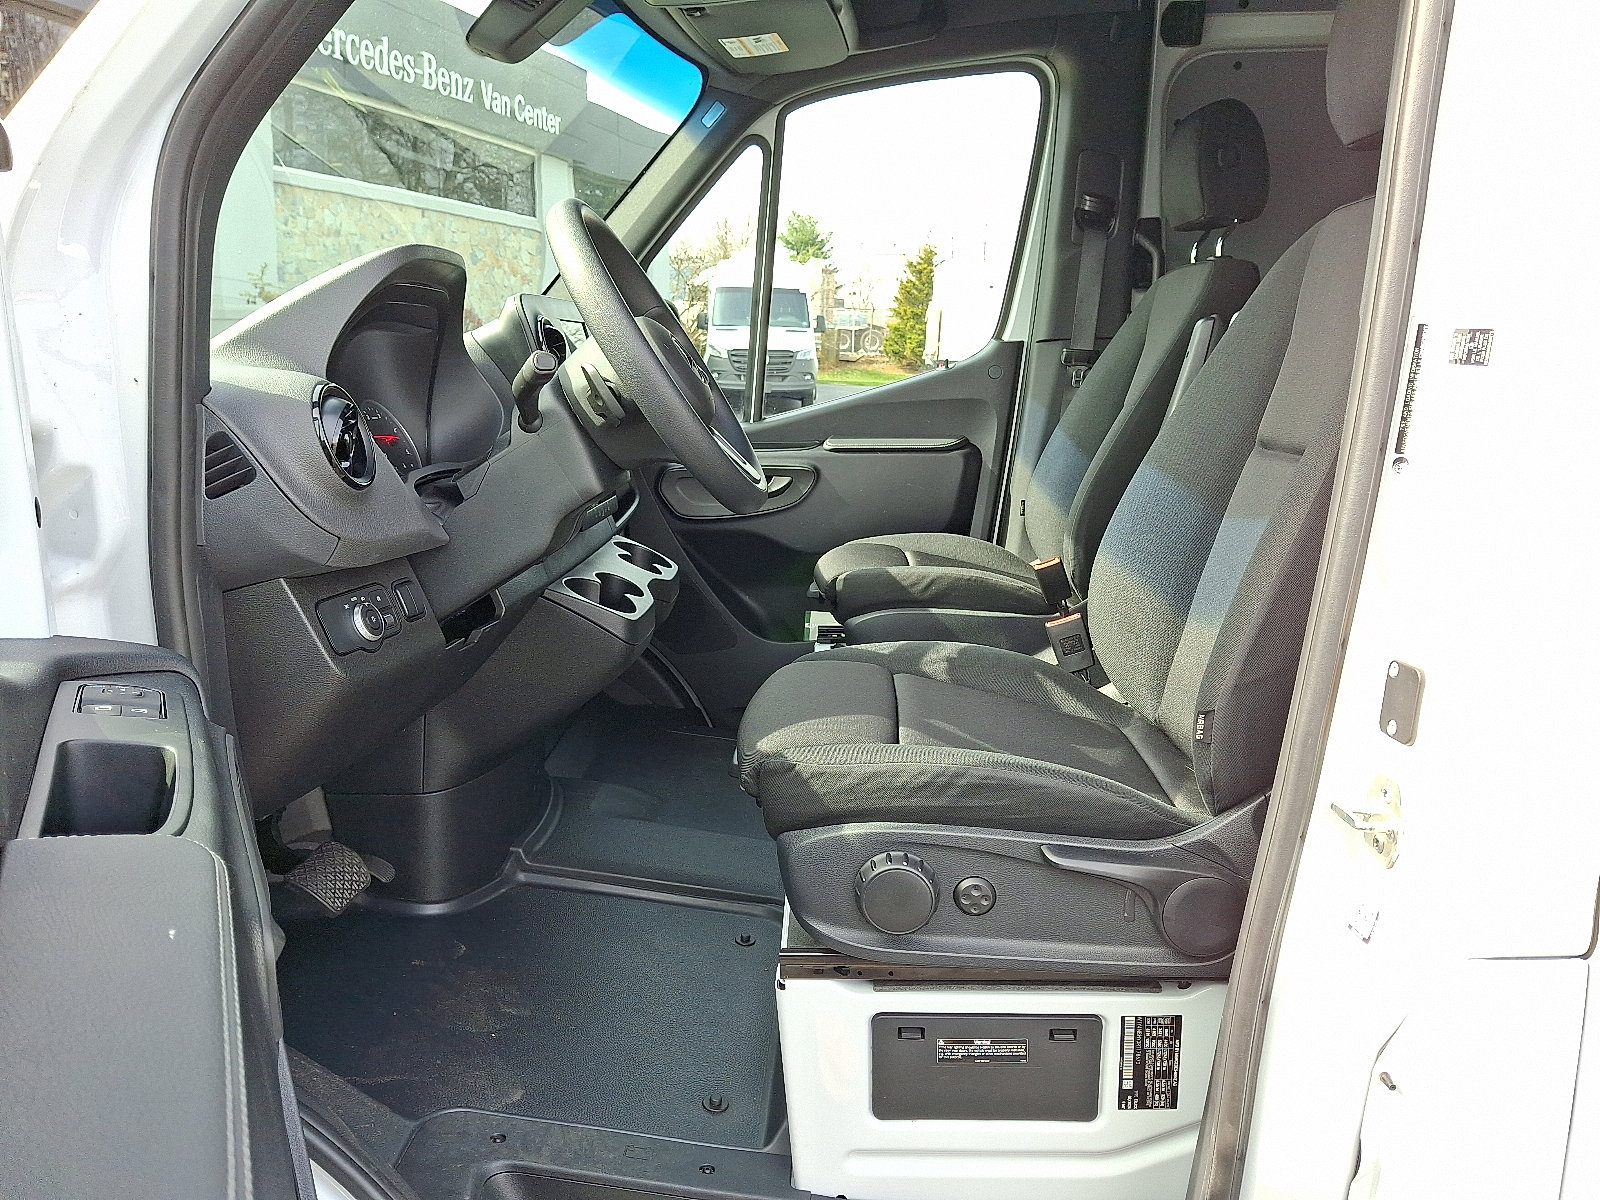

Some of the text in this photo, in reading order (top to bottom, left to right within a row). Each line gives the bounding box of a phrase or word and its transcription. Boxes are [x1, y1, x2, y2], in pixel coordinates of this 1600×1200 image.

[317, 28, 562, 135] ercedes-Benz Van Center
